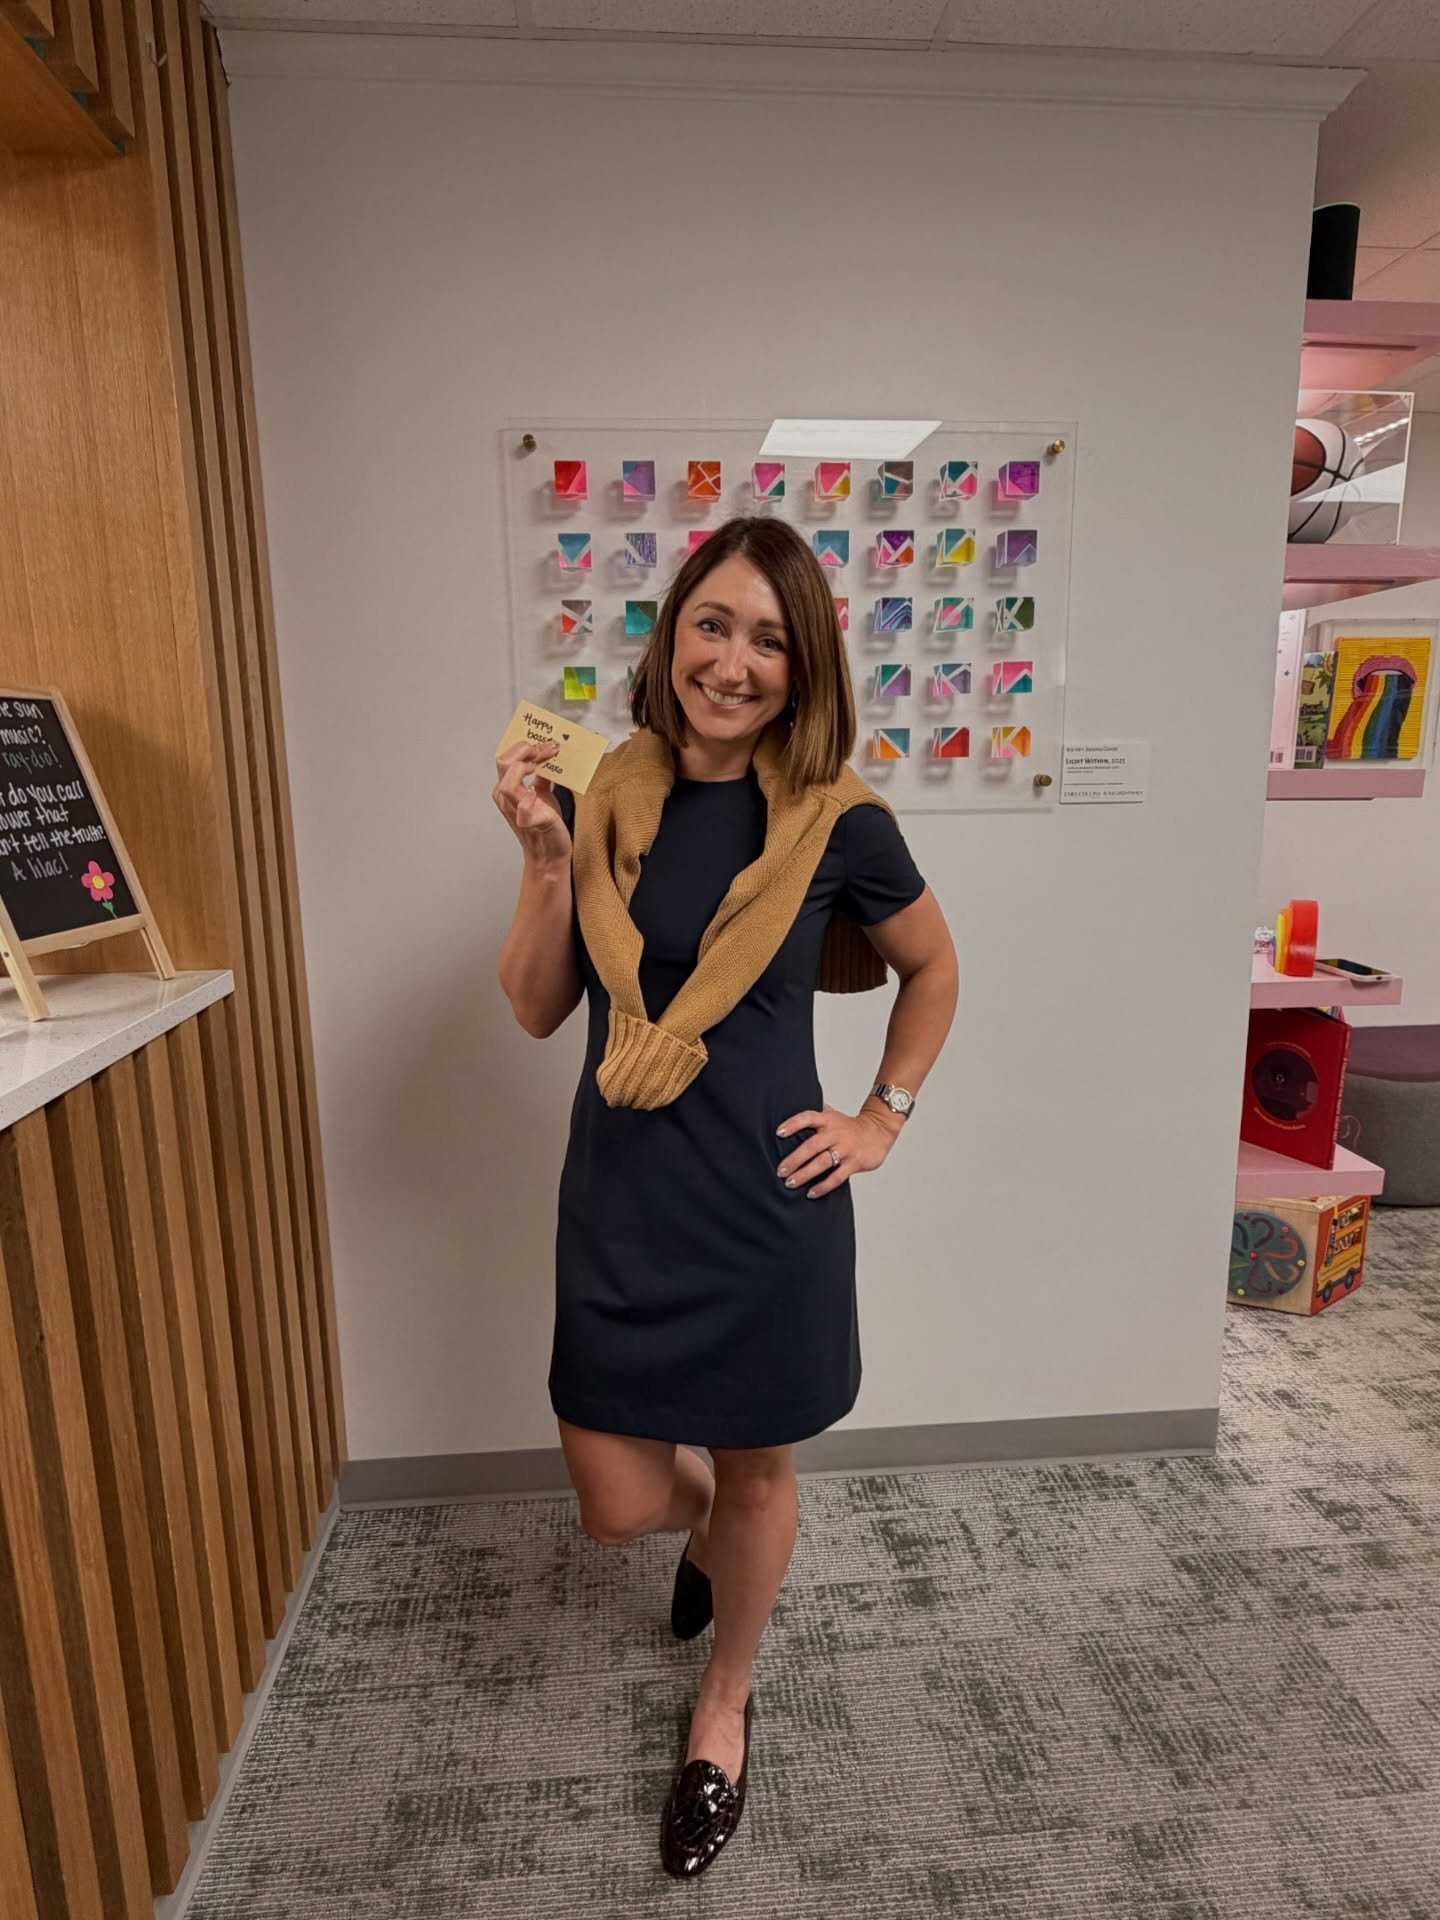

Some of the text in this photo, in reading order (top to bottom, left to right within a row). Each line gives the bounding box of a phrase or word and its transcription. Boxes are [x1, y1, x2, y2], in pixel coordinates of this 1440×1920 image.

[13, 701, 44, 719] sun
[523, 713, 553, 734] Happy
[0, 724, 46, 746] music?
[8, 782, 28, 806] do
[26, 783, 58, 808] you
[56, 780, 84, 802] call
[35, 804, 69, 826] that
[23, 831, 50, 854] tell
[50, 829, 74, 848] the
[11, 861, 27, 881] A
